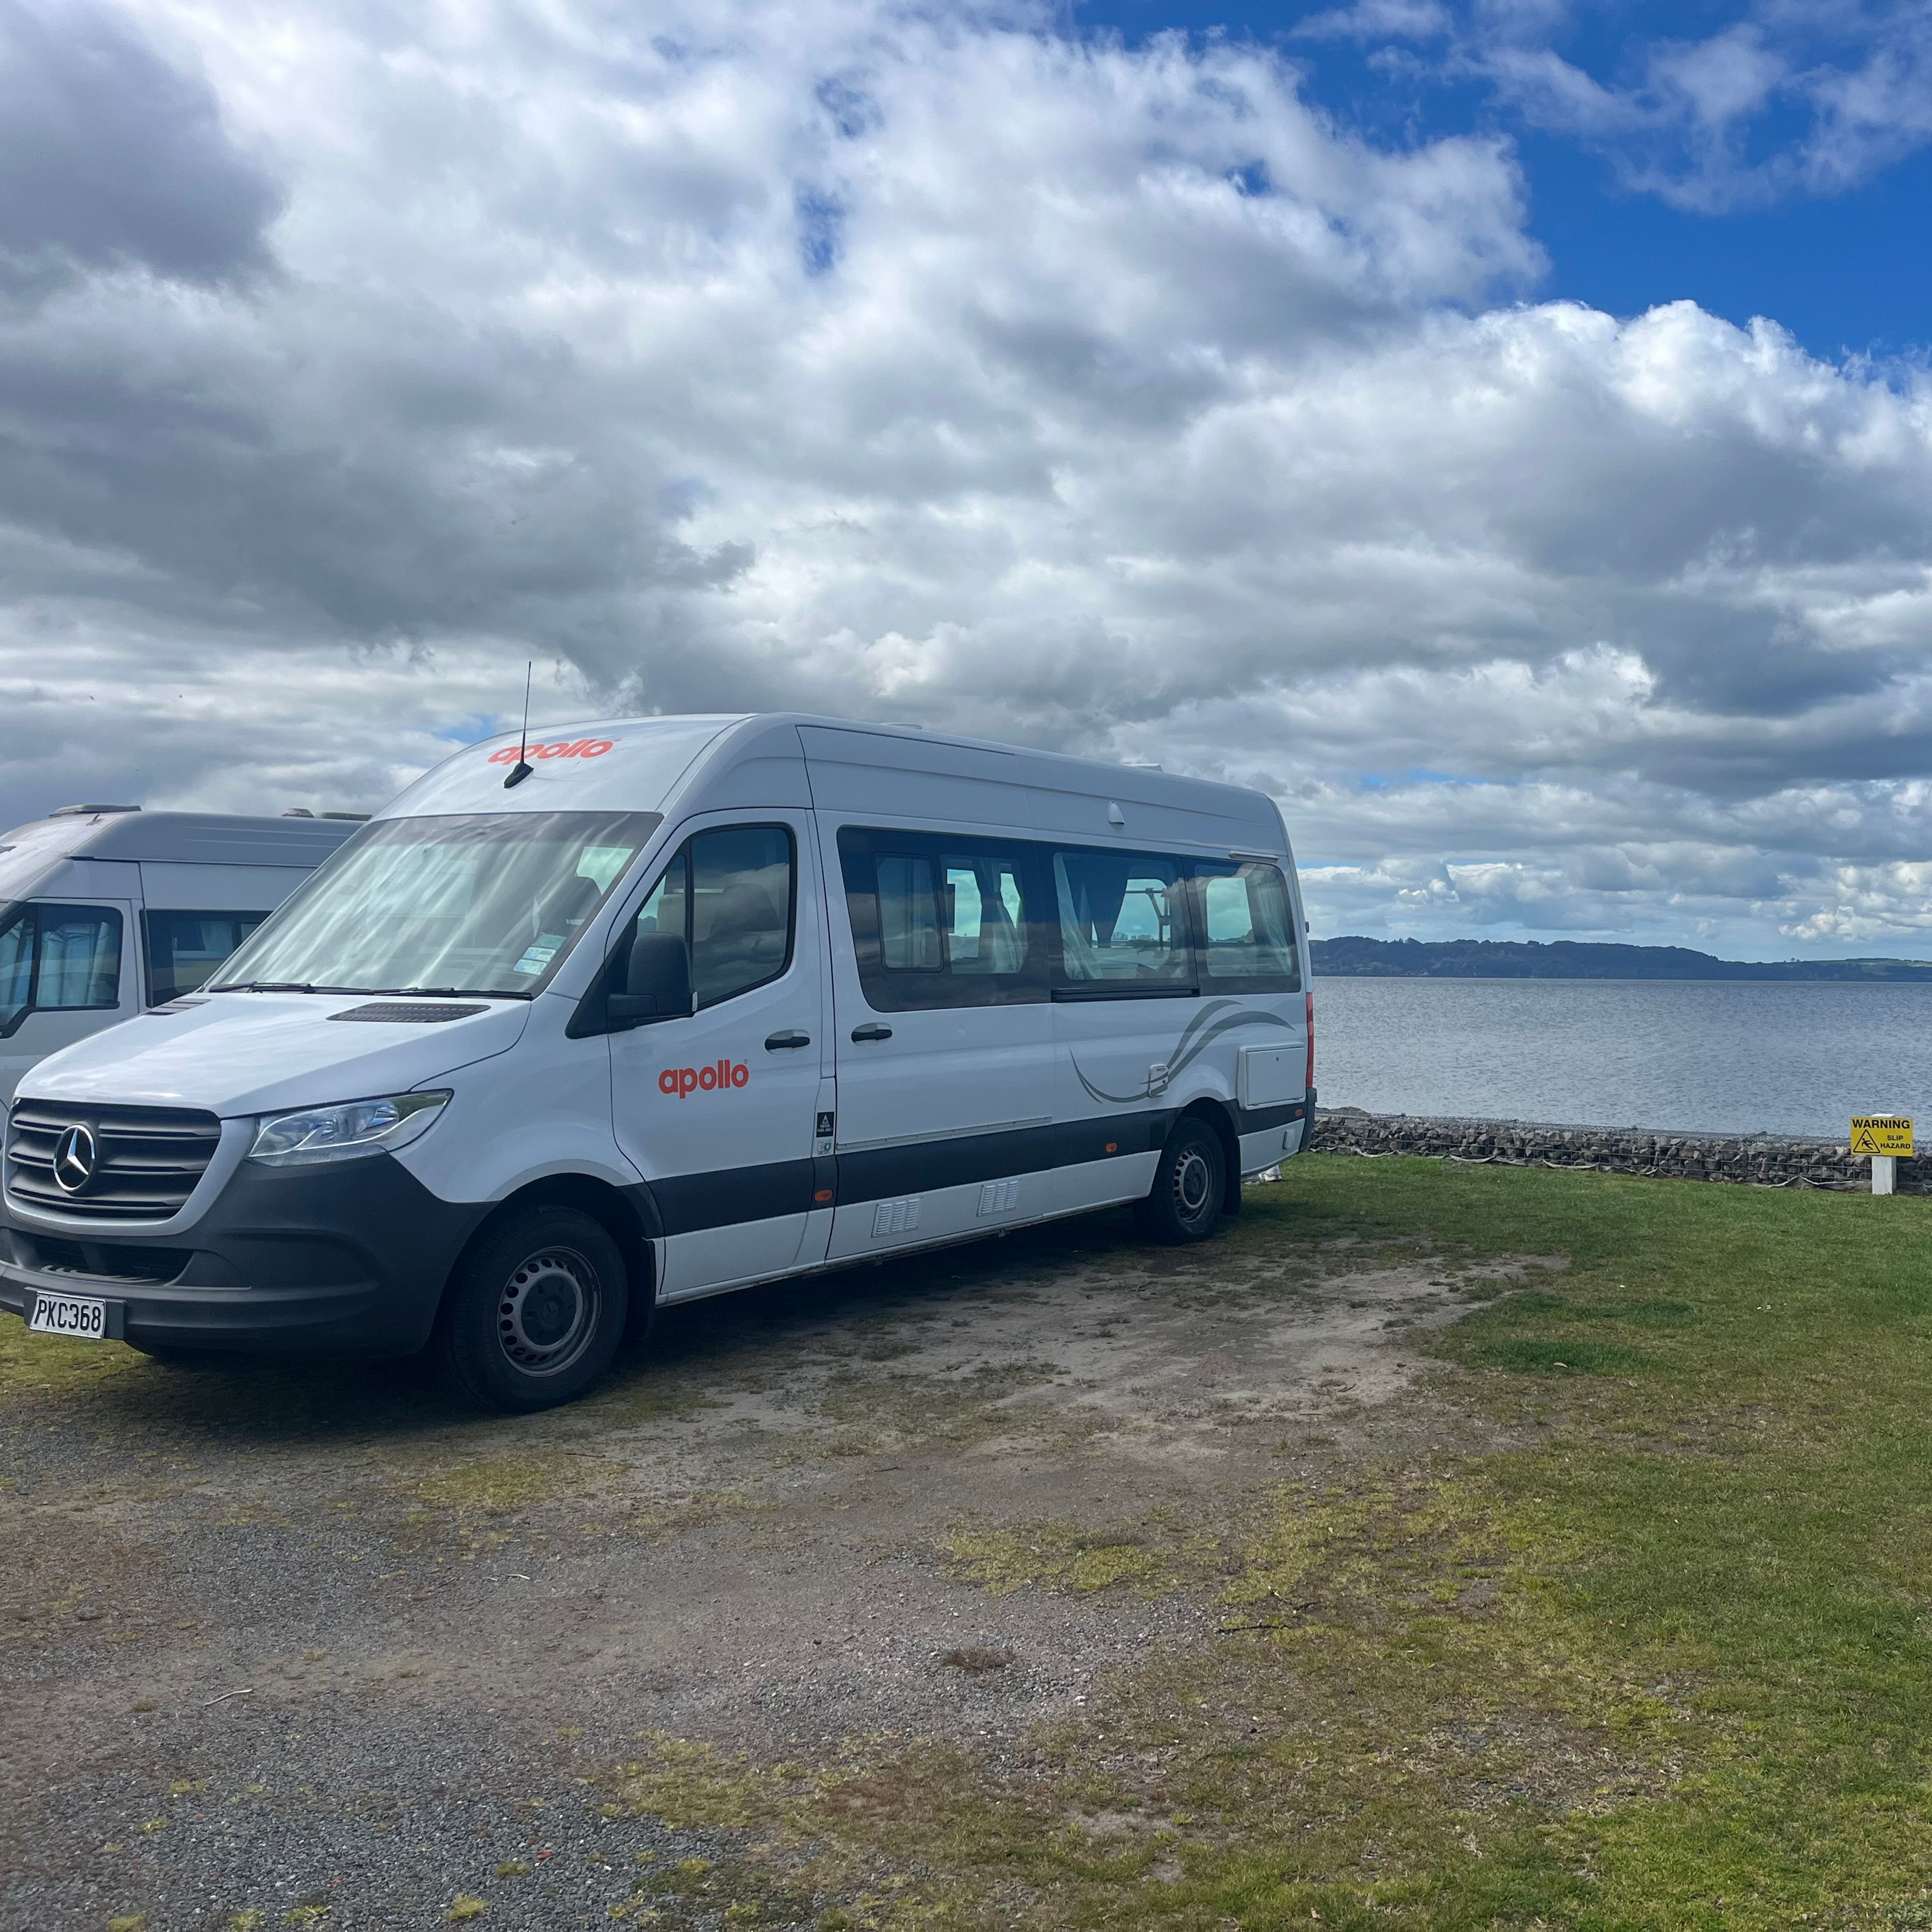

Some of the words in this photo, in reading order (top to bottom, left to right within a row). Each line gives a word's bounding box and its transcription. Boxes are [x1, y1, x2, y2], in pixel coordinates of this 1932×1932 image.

[488, 739, 613, 765] apollo
[658, 1059, 749, 1099] apollo
[1852, 1119, 1910, 1129] WARNING
[34, 1299, 101, 1332] PKC368
